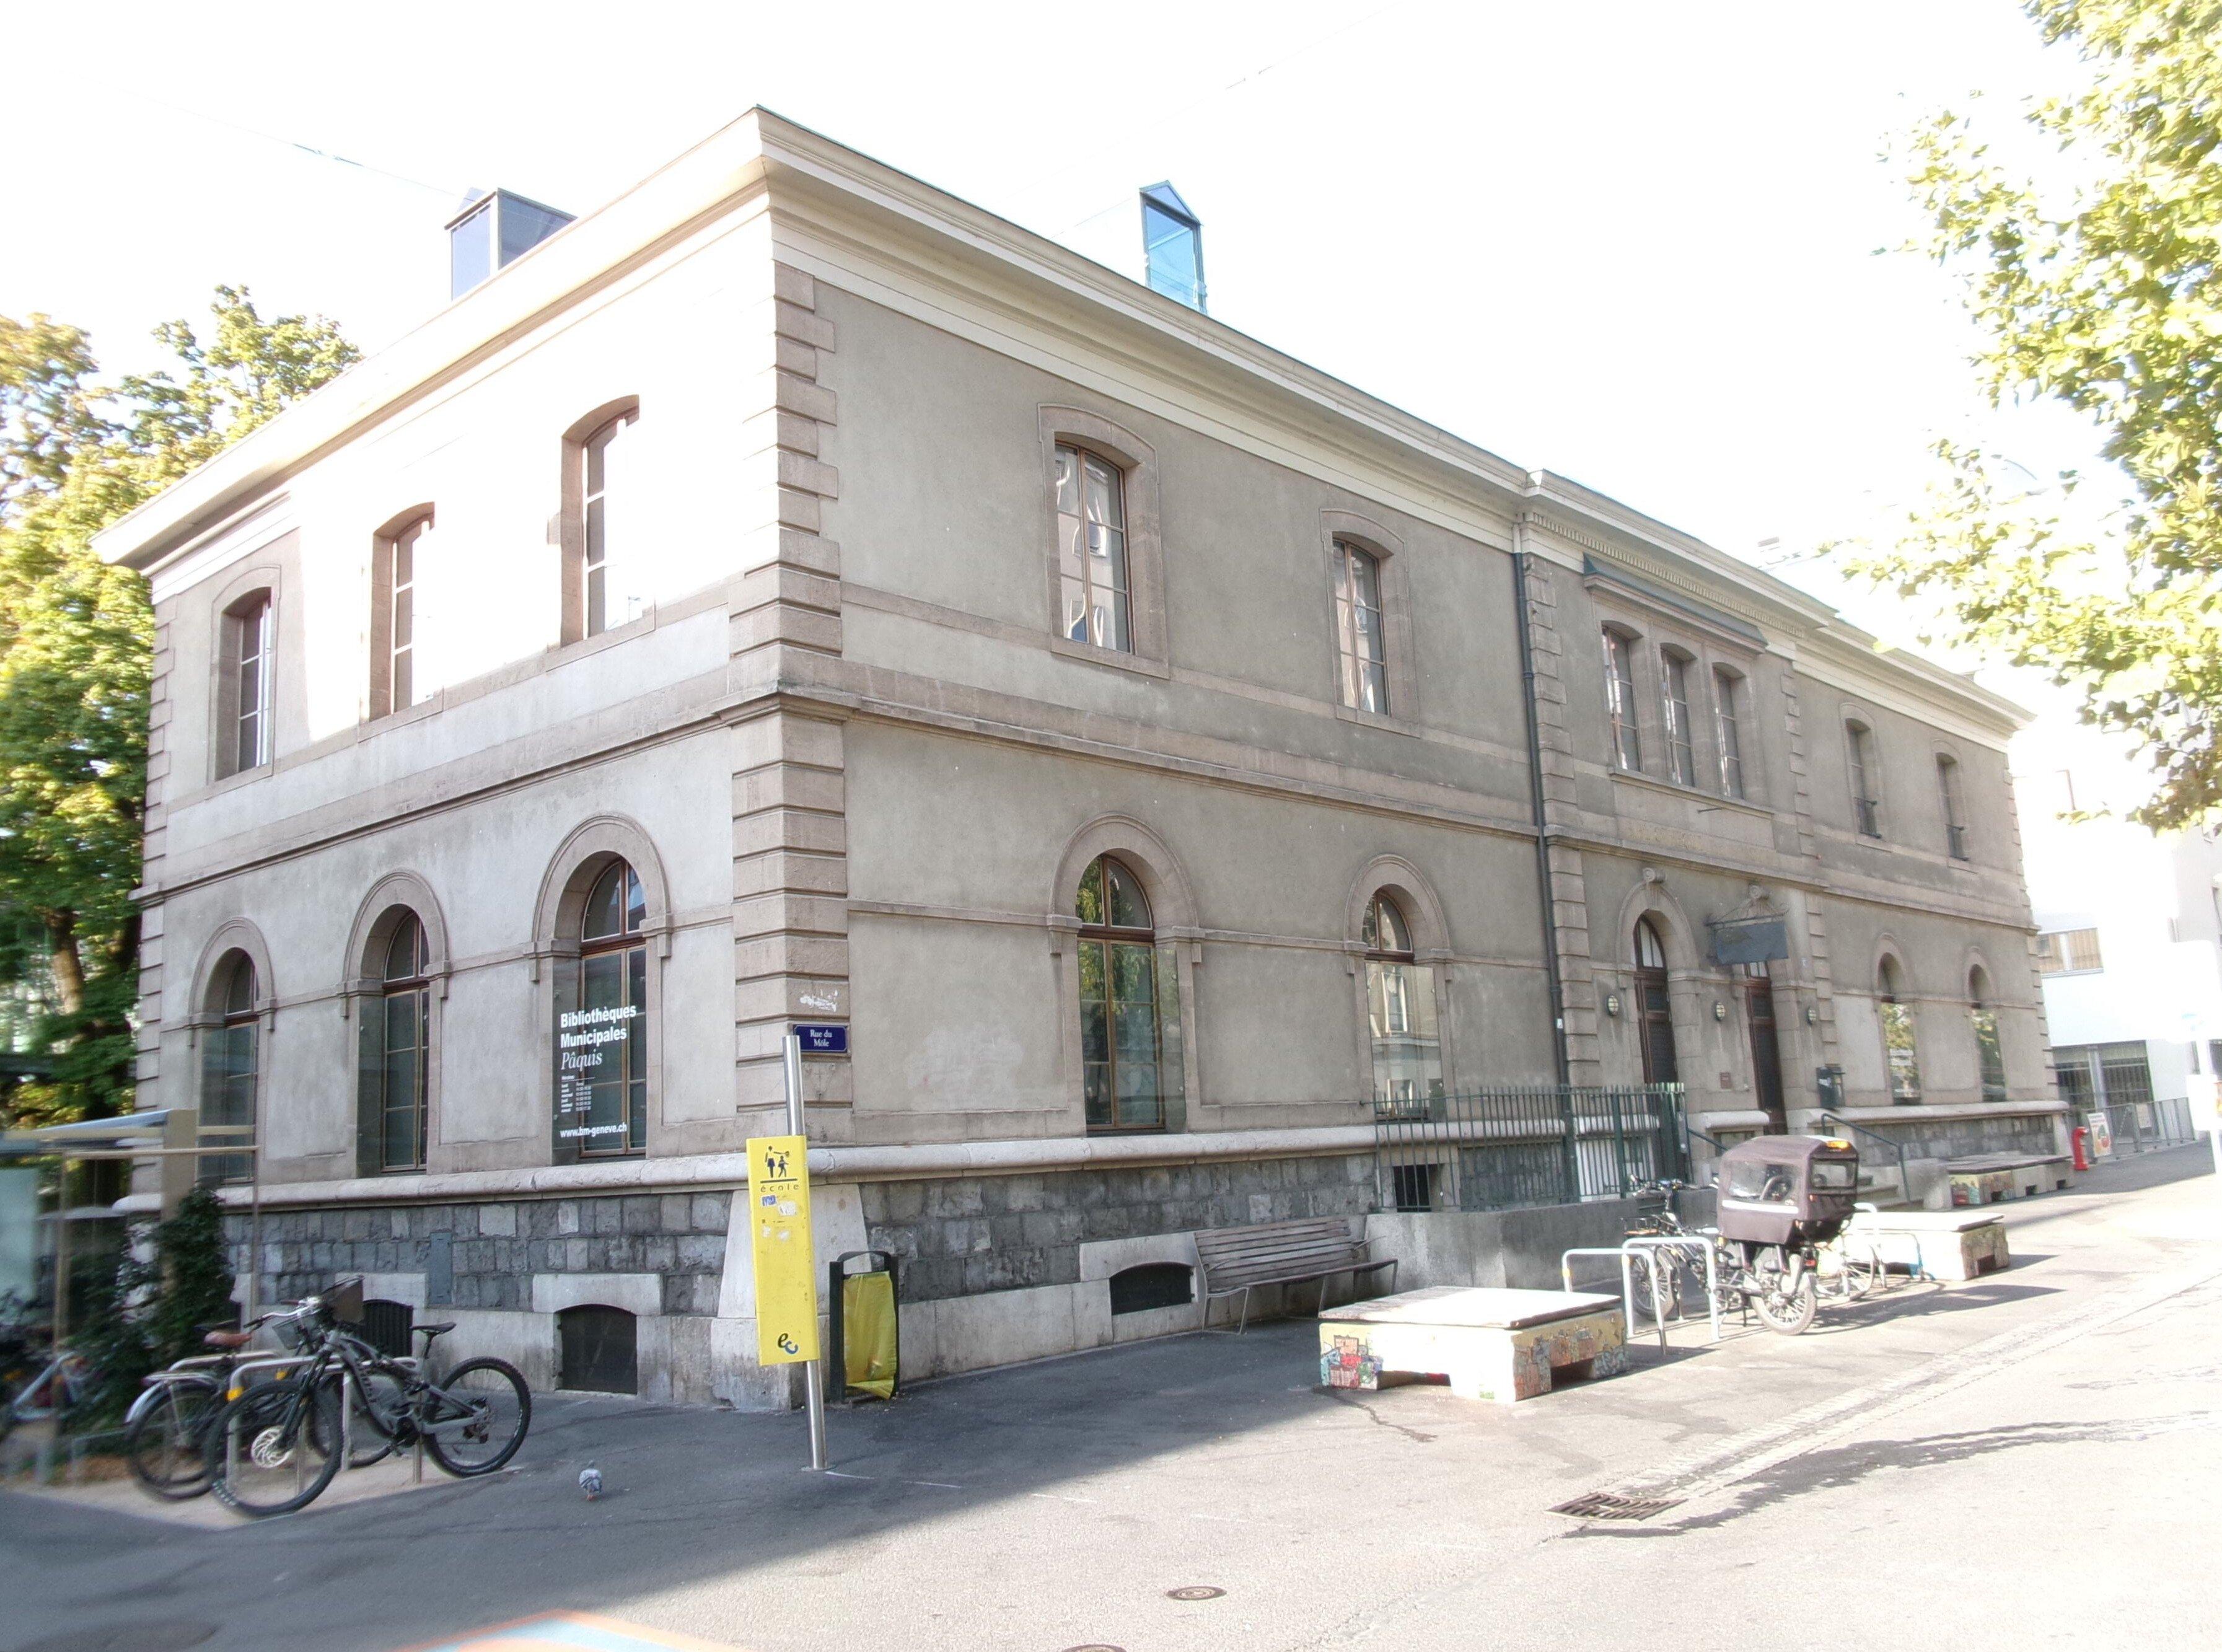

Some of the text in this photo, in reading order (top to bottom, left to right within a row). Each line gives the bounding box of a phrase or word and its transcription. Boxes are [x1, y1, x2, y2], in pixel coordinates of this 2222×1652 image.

[561, 1005, 636, 1028] Bibliothèques
[561, 1026, 627, 1048] Municipales
[810, 1029, 832, 1037] Rue du
[561, 1048, 602, 1071] Pâquis
[560, 1122, 627, 1138] www.bm-geneve.ch
[760, 1184, 799, 1192] école
